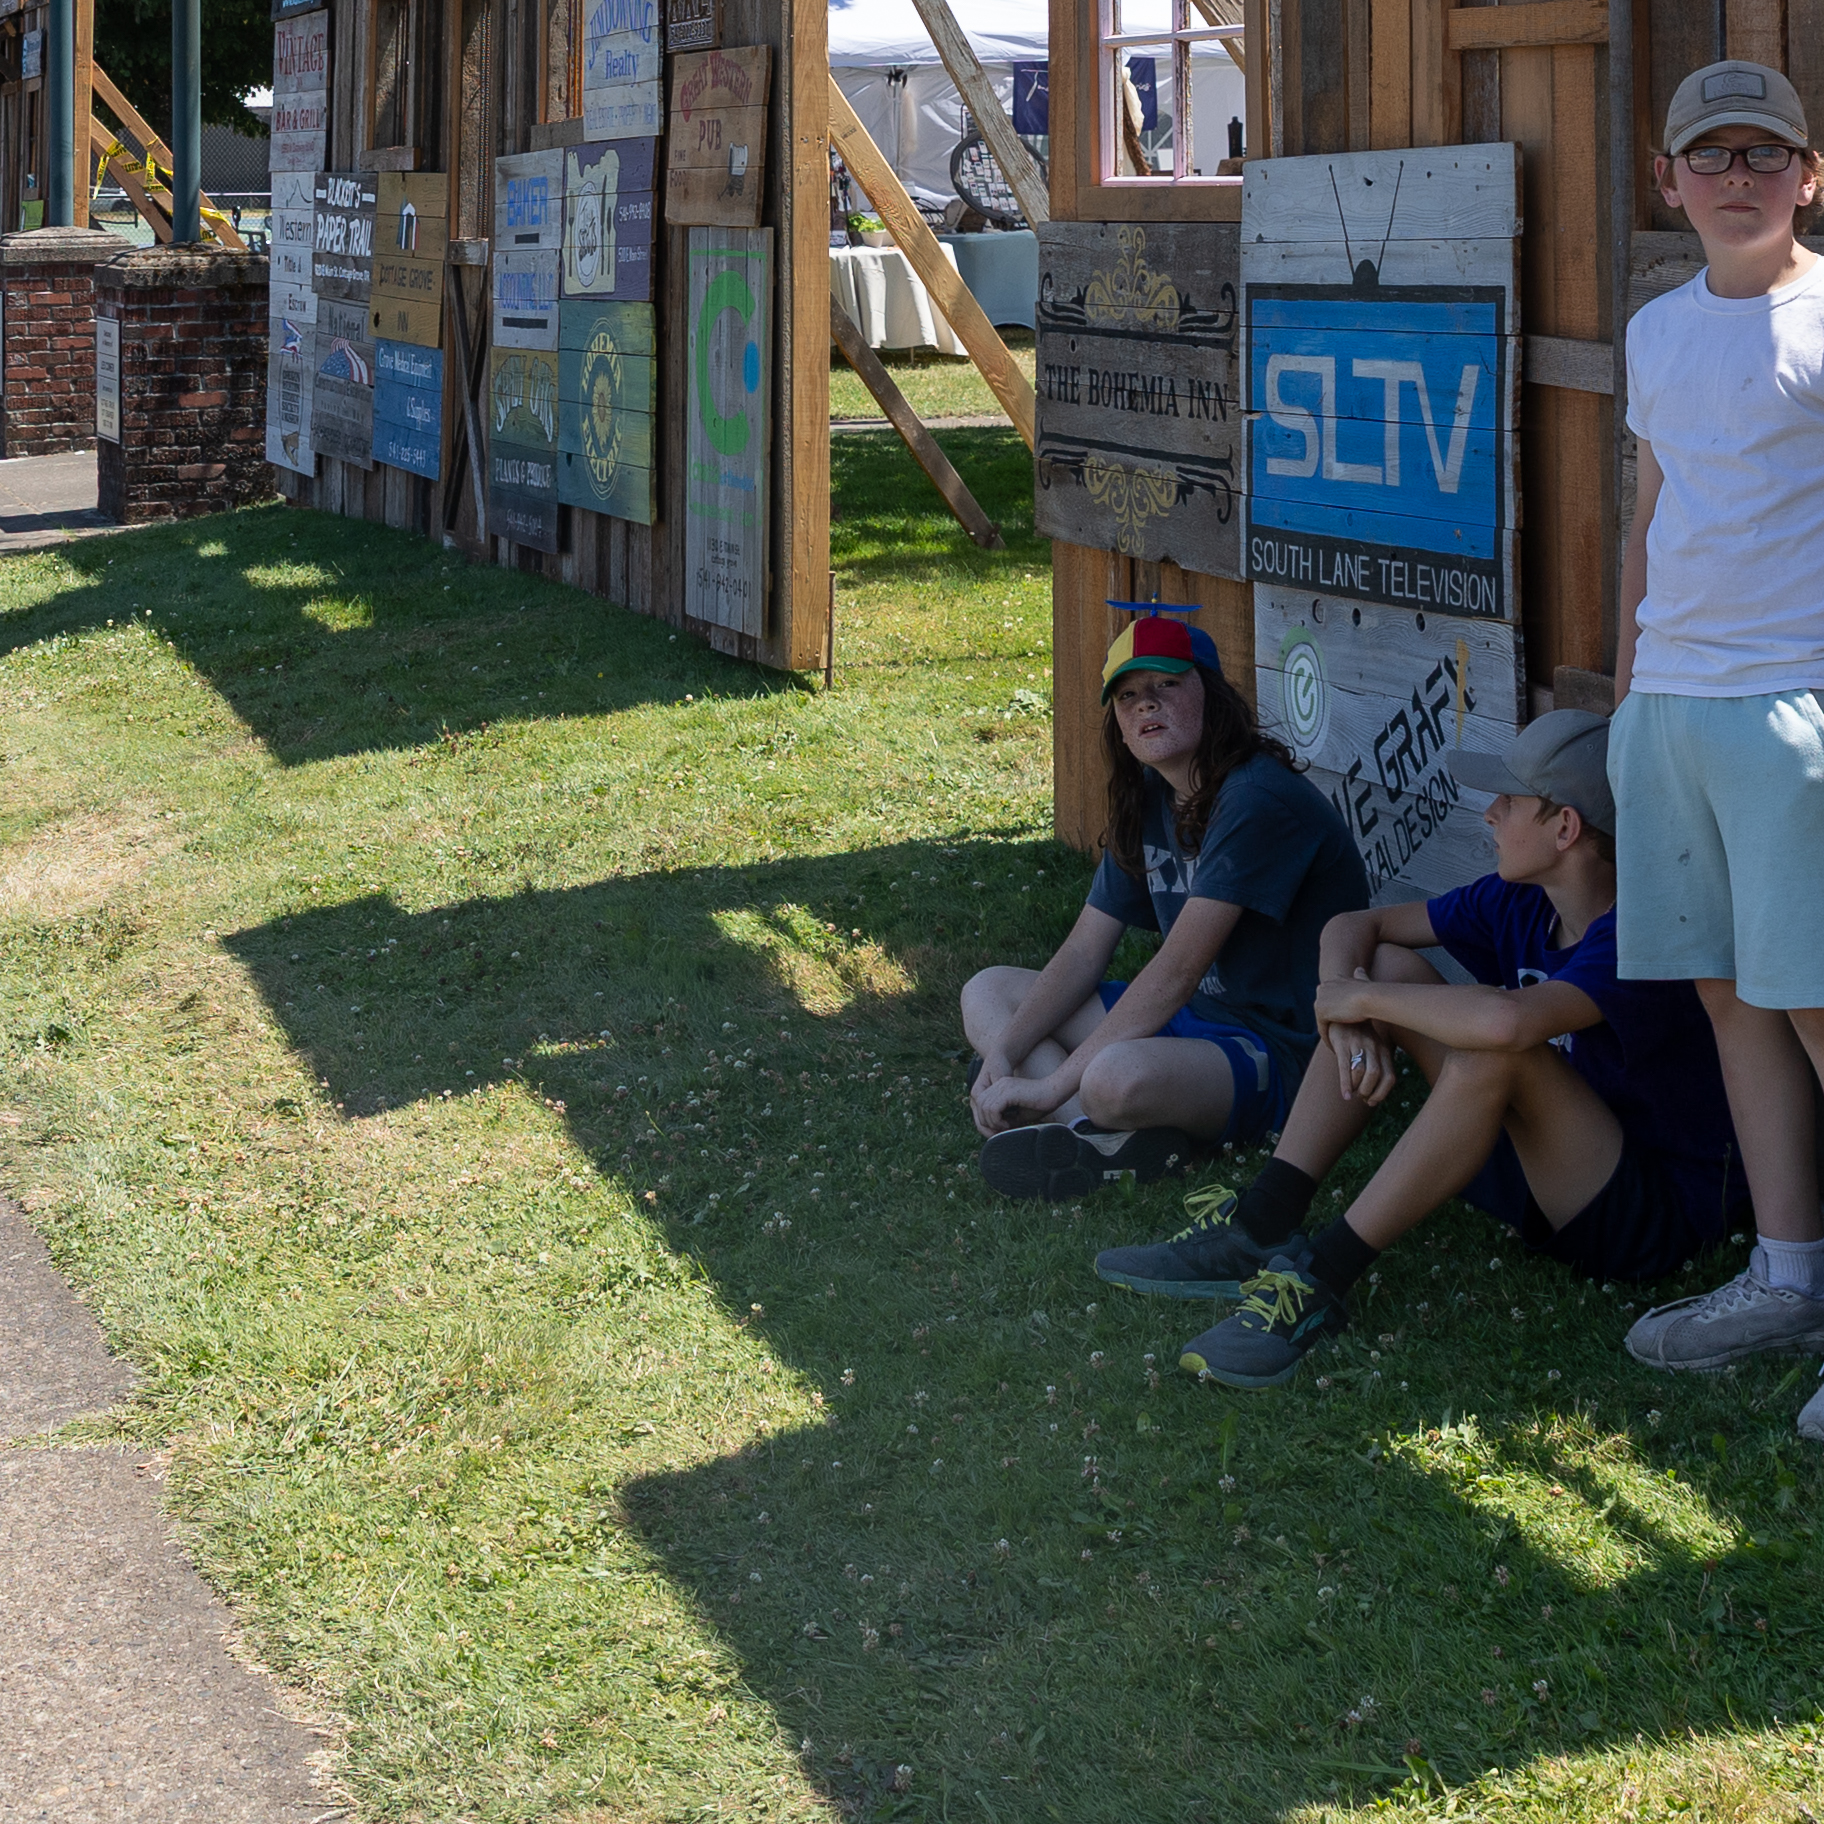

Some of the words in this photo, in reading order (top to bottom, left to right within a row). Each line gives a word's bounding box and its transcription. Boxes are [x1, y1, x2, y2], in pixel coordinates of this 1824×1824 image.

[277, 30, 324, 76] VINTAGE
[606, 49, 639, 87] Realty
[276, 110, 291, 131] BAR
[293, 109, 299, 129] &
[300, 108, 320, 129] GRILL
[698, 118, 722, 152] PUB
[279, 215, 312, 241] Western
[316, 213, 347, 254] PAPER
[349, 218, 372, 256] TRAIL
[409, 268, 433, 291] GROVE
[379, 347, 394, 370] Grove
[581, 332, 622, 394] BOHEMIA
[1044, 363, 1082, 407] THE
[1088, 367, 1180, 419] BOHEMIA
[1187, 376, 1229, 424] INN
[1264, 352, 1480, 494] SLTV
[495, 457, 520, 485] PLANTS
[1251, 536, 1313, 582] SOUTH
[1318, 549, 1371, 593] LANE
[1377, 559, 1497, 614] TELEVISION
[1393, 768, 1459, 867] DESIGN
